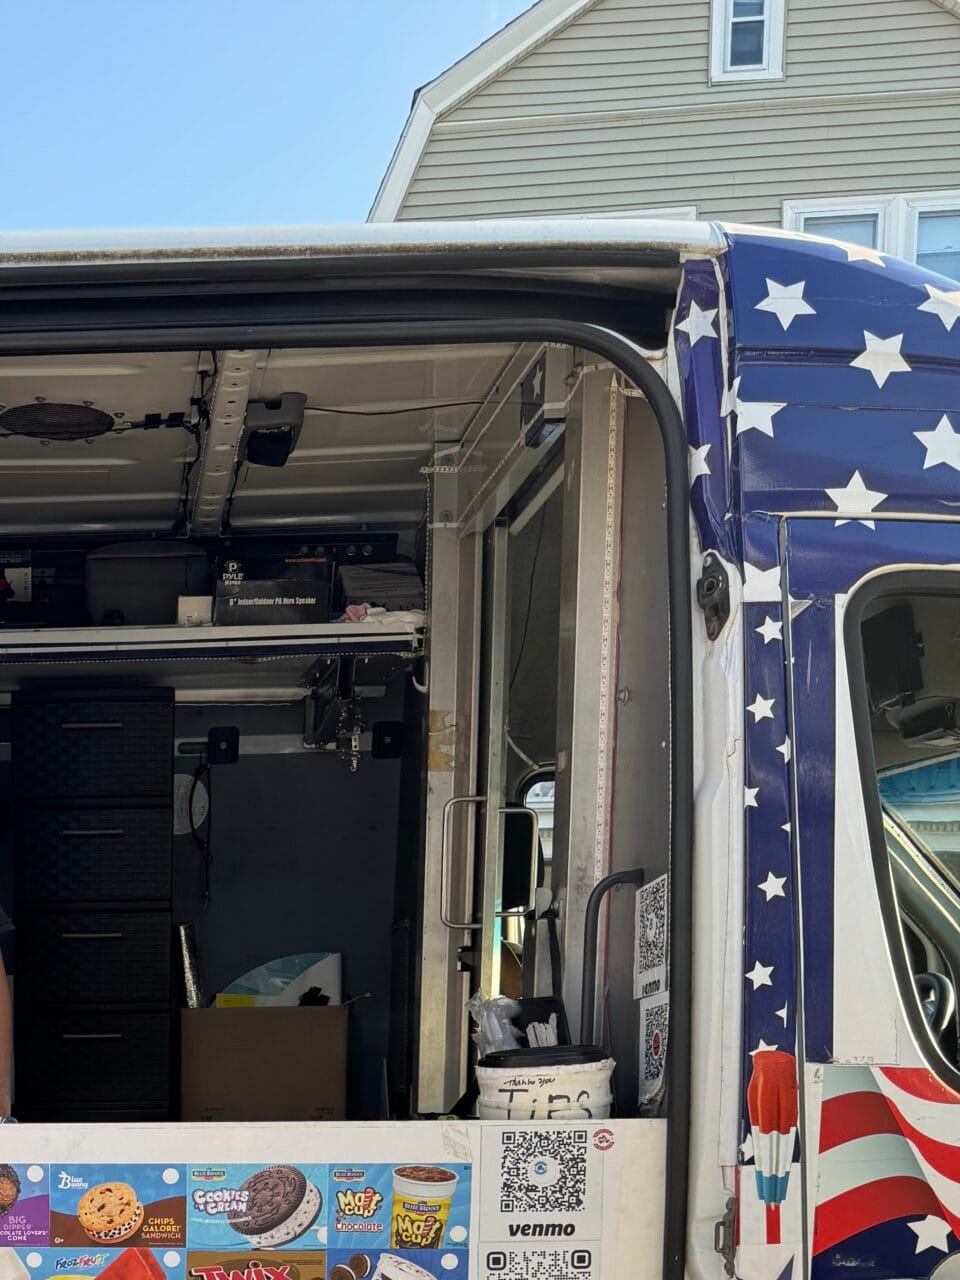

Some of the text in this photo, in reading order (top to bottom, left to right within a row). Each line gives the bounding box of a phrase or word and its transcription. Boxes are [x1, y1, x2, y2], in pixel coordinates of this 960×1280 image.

[193, 1188, 249, 1204] COOKIES
[207, 1201, 247, 1214] CREAM
[8, 1216, 26, 1224] BIG
[335, 1222, 383, 1232] Chocolate
[508, 1223, 576, 1237] venmo
